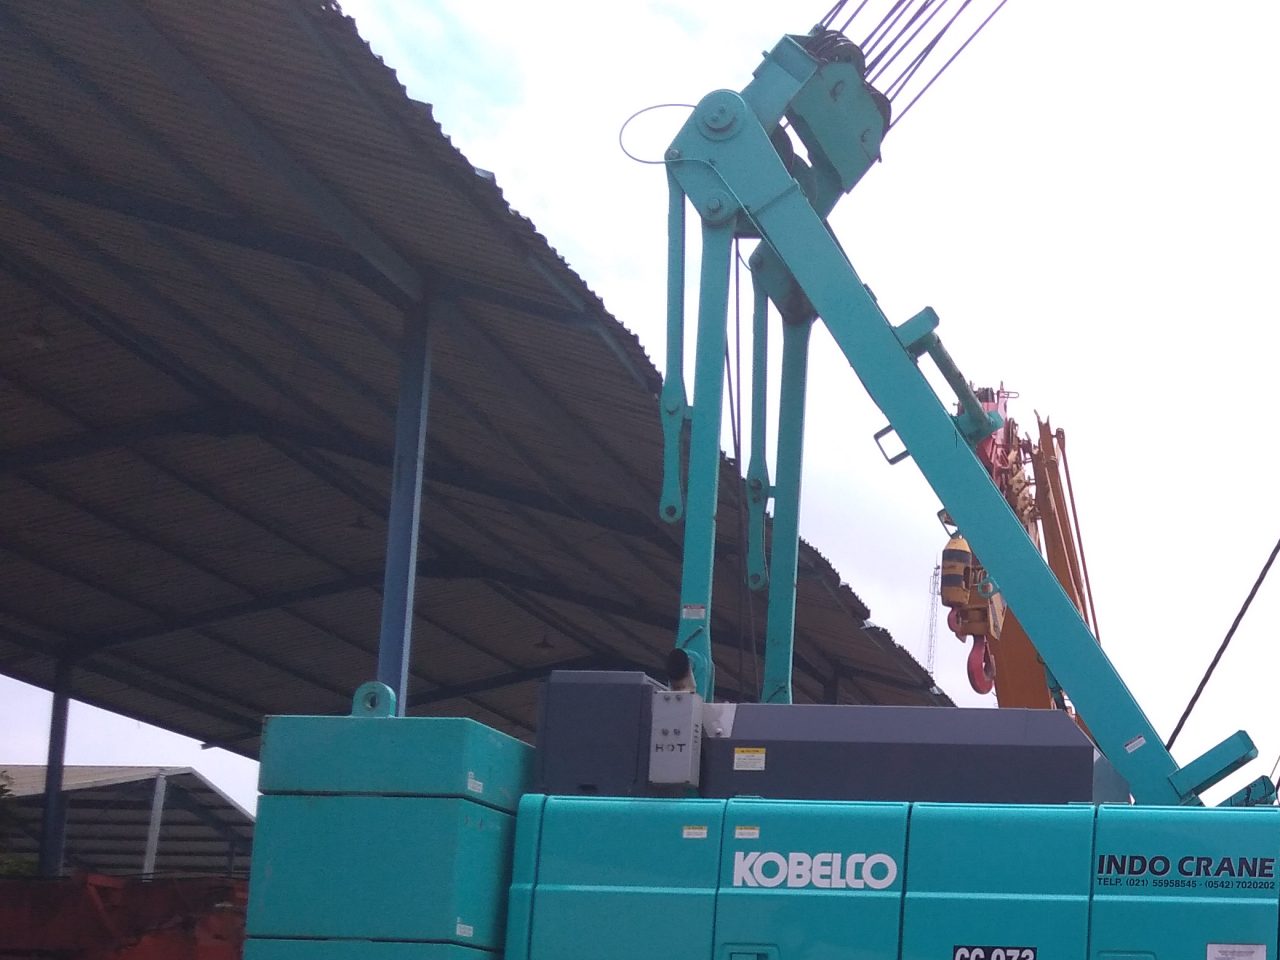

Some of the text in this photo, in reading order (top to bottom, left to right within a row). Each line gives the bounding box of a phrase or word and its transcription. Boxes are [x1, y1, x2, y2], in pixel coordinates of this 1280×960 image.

[655, 743, 687, 753] HOT
[733, 851, 898, 889] KOBELCO
[1097, 854, 1276, 878] INDO CRANE
[1126, 879, 1149, 887] (021)
[1152, 880, 1197, 888] 55958545
